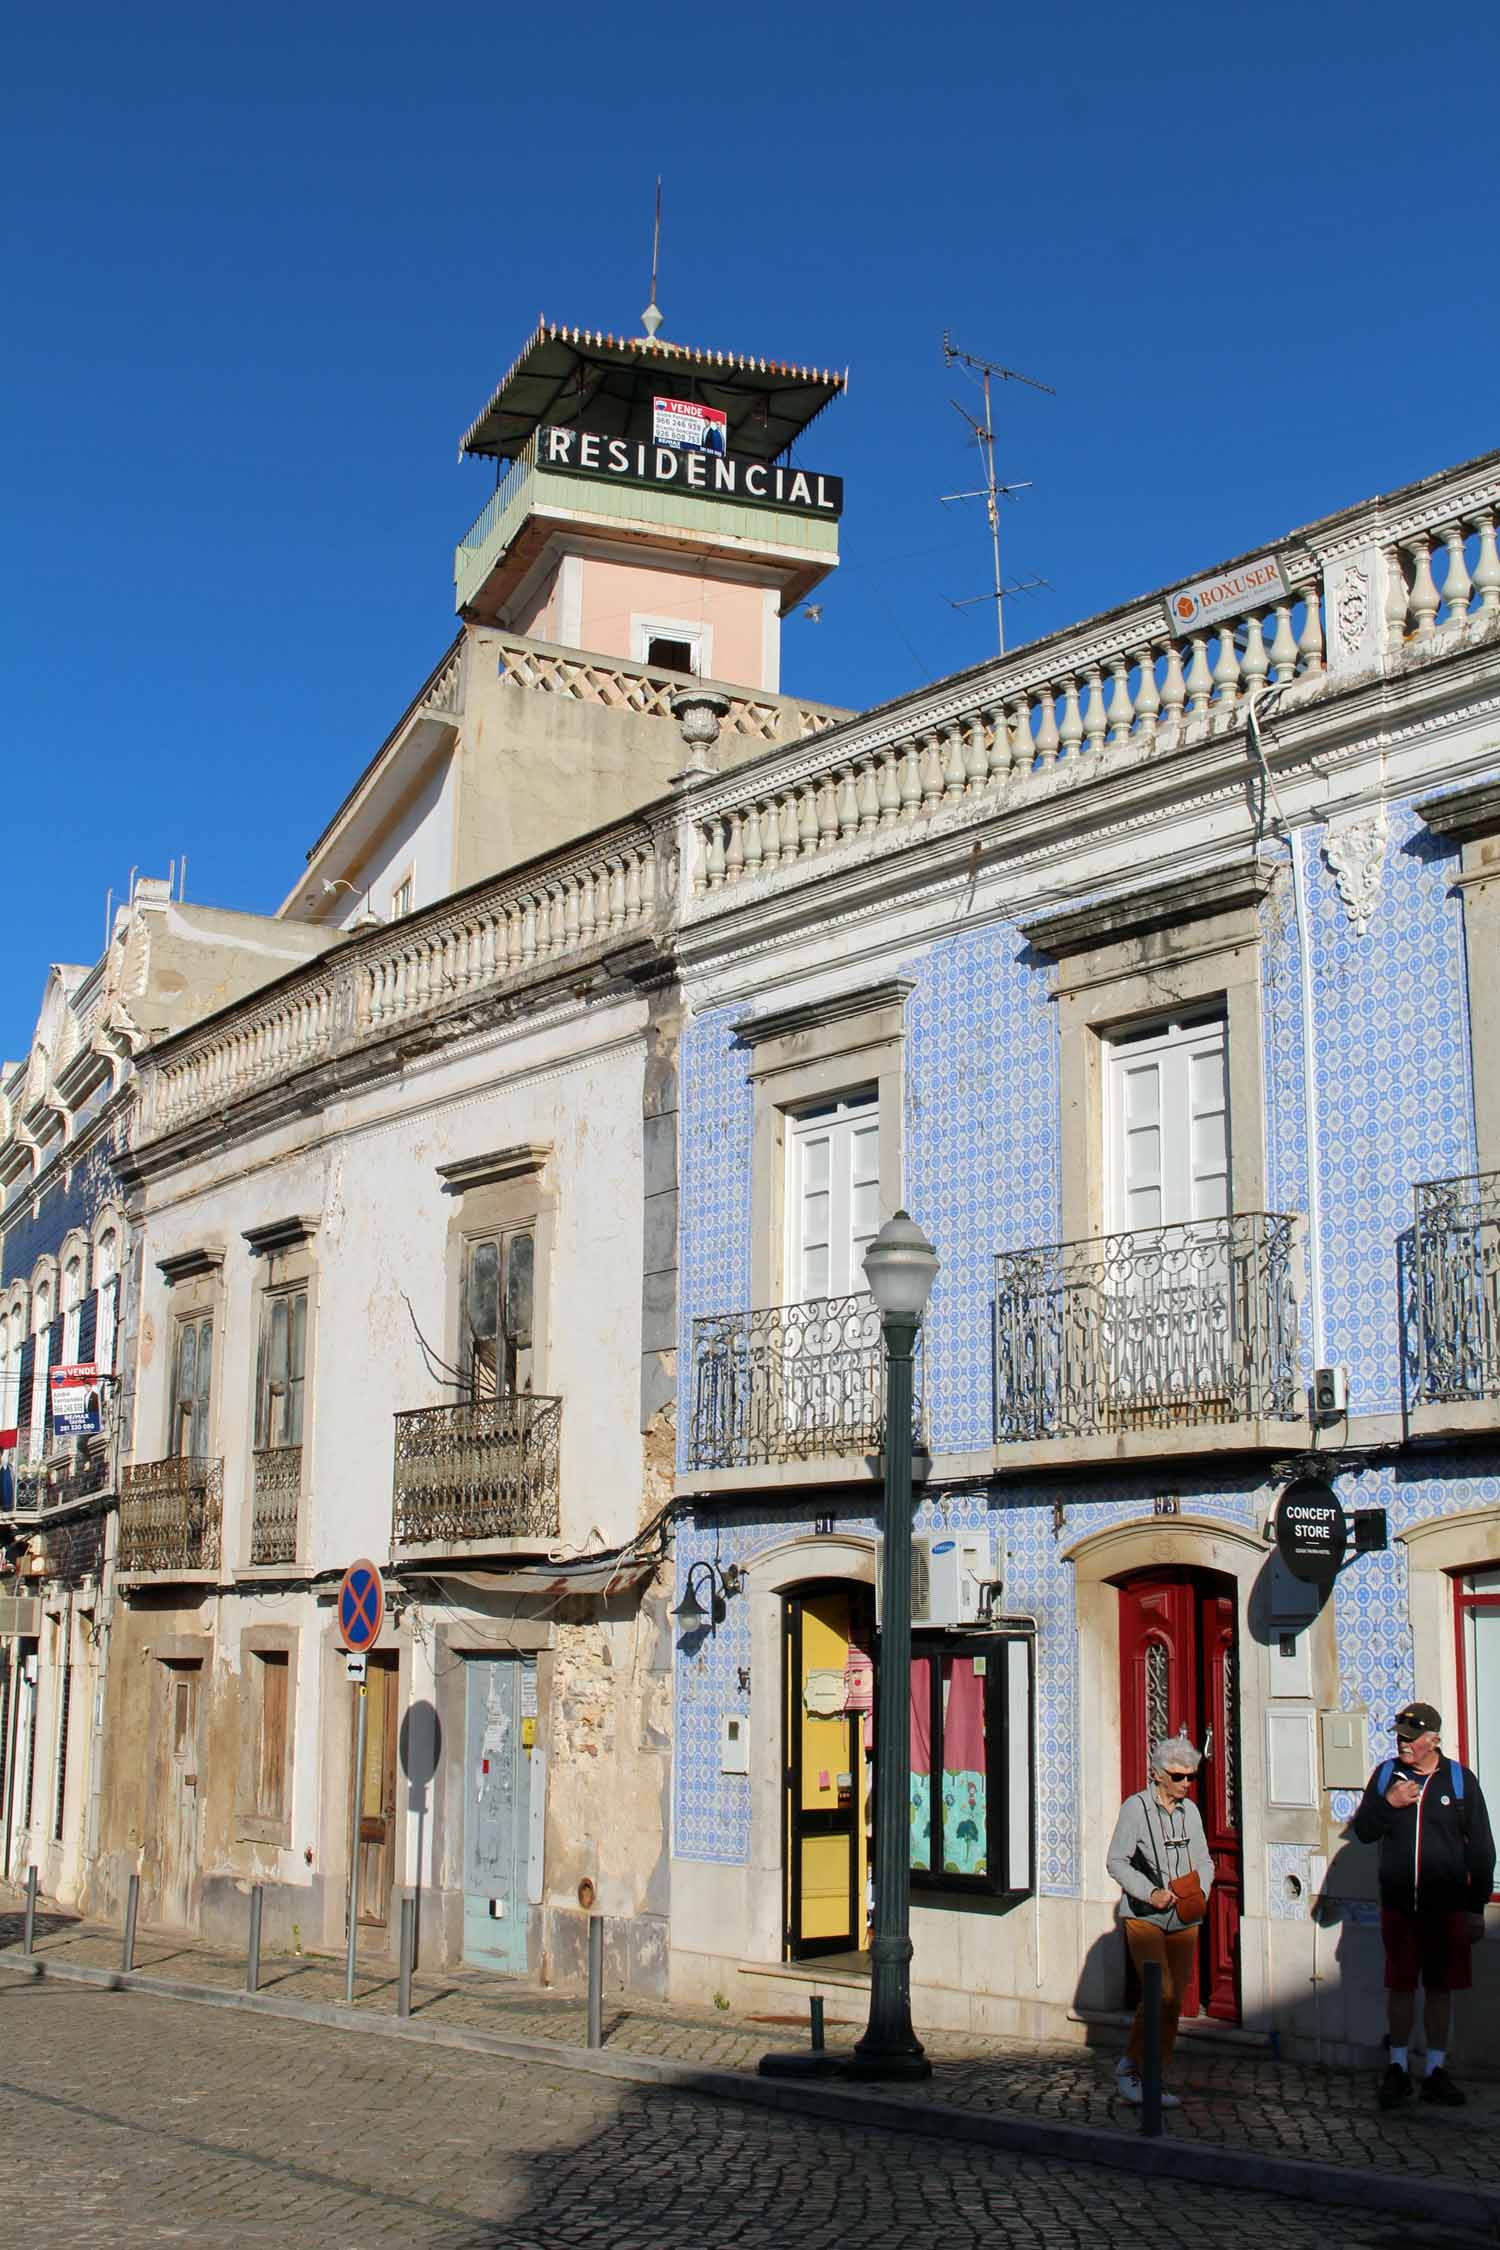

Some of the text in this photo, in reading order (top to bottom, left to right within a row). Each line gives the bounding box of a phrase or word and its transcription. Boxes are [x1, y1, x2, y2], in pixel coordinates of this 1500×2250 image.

[670, 402, 704, 417] VENDE
[549, 431, 834, 509] RESIDENCIAL
[1199, 564, 1278, 608] BOXUSER
[67, 1366, 96, 1377] VENDE
[1156, 1496, 1175, 1513] 93
[1286, 1506, 1336, 1521] CONCEPT
[816, 1517, 831, 1532] 91
[1294, 1524, 1331, 1538] STORE
